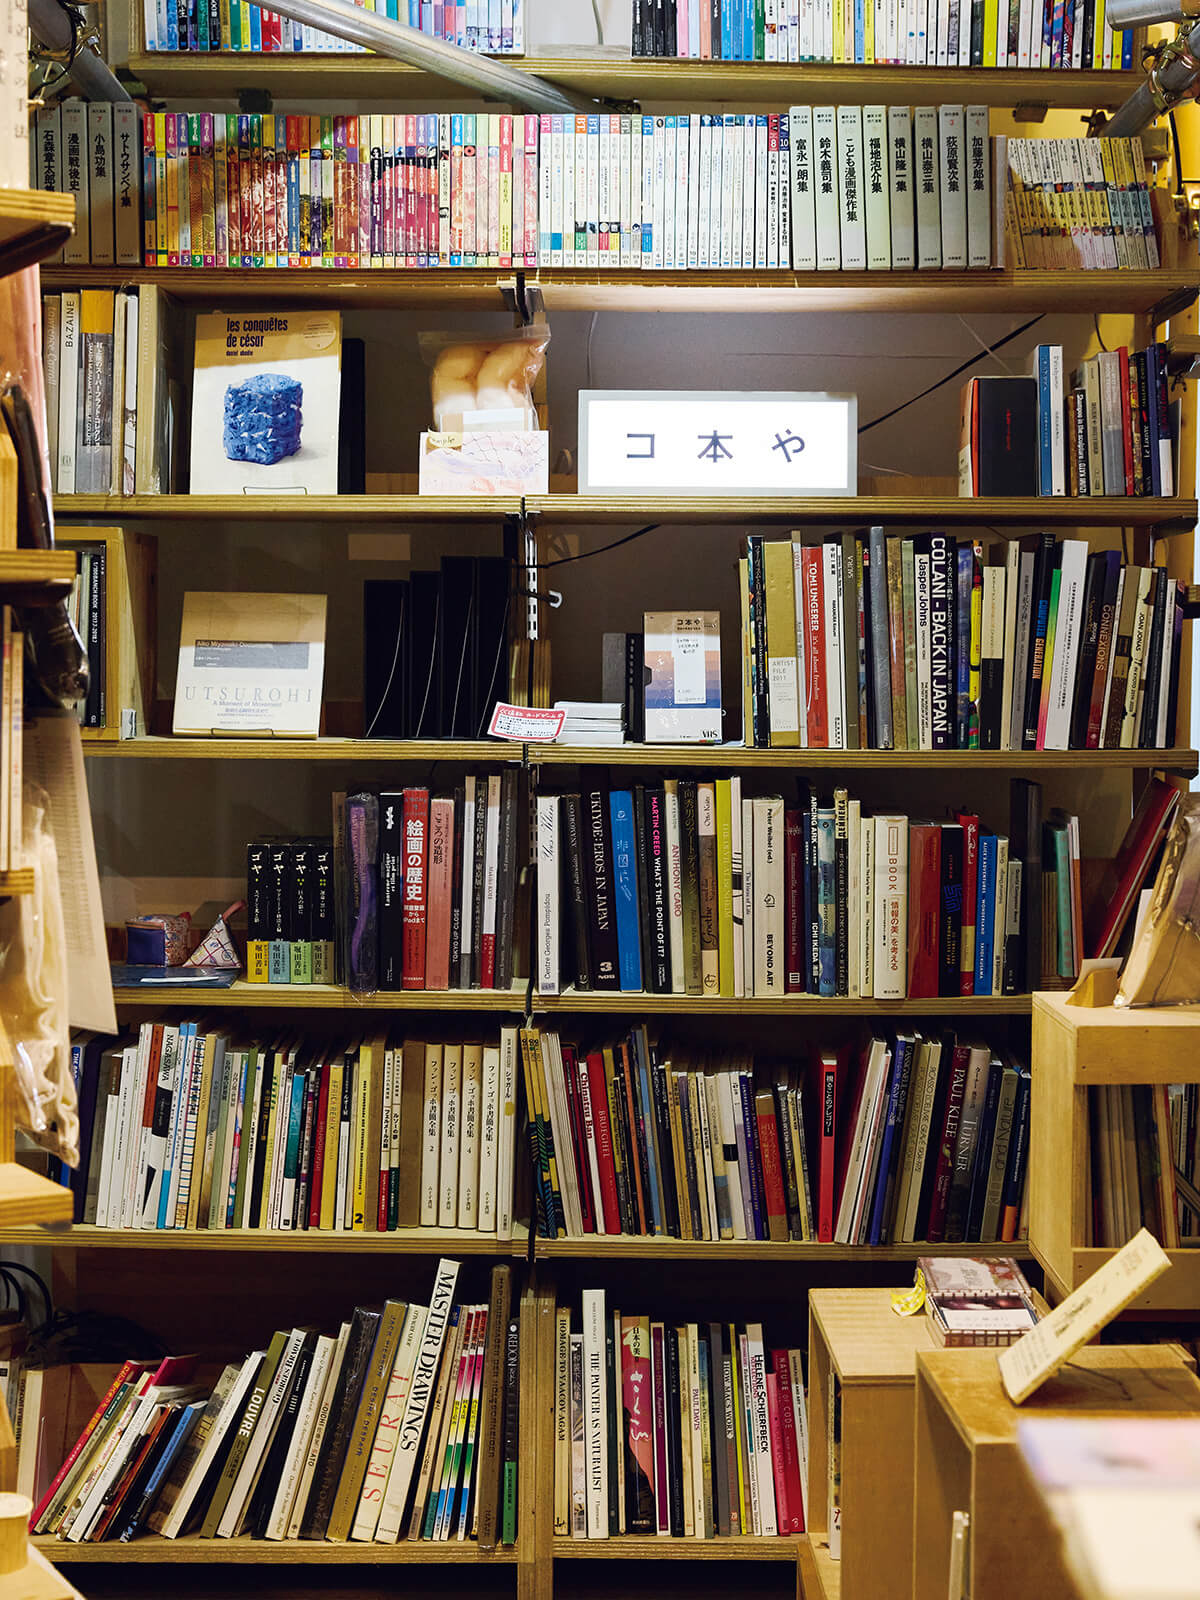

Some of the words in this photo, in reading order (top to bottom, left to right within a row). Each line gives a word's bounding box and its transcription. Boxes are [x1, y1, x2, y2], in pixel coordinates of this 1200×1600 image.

[94, 134, 106, 178] 小島功集
[770, 139, 776, 148] 8
[779, 138, 789, 147] 10
[68, 133, 81, 191] 漫画戦後史
[120, 133, 132, 207] サトウサンペイ集
[796, 138, 808, 193] 富永一朗集
[819, 137, 832, 194] 鈴木義司集
[869, 137, 882, 193] 福地泡介集
[894, 137, 907, 192] 横山隆一集
[921, 137, 934, 193] 横山泰三集
[971, 136, 984, 191] 加藤芳郎集
[845, 138, 858, 222] こども漫画傑作集
[65, 300, 75, 347] BAZAINE
[226, 334, 237, 347] de
[239, 332, 264, 347] césar
[227, 318, 240, 332] les
[243, 316, 288, 335] conquêtes
[626, 428, 806, 463] コ本や
[809, 562, 817, 586] TOMI
[918, 558, 929, 592] Jasper
[931, 537, 945, 598] COLANI
[810, 587, 819, 631] UNGERER
[919, 595, 929, 627] Johns
[1035, 600, 1048, 637] COMPUTER
[1138, 611, 1146, 629] JOAN
[932, 611, 946, 656] BACK
[1095, 603, 1115, 671] CONNEXIONS
[1135, 631, 1143, 651] JONAS
[933, 660, 946, 676] IN
[1032, 638, 1045, 680] GENERATION
[185, 686, 313, 703] UTSUROHI
[933, 680, 947, 730] JAPAN
[702, 729, 718, 739] VHS
[652, 797, 660, 828] MARTIN
[810, 796, 818, 825] ARCING
[837, 799, 847, 838] ДЕЙНЕКА
[433, 812, 443, 865] こころの造形
[653, 829, 661, 856] CREED
[251, 850, 263, 875] ゴヤ
[273, 850, 285, 875] ゴヤ
[296, 850, 307, 875] ゴヤ
[317, 850, 329, 875] ゴヤ
[406, 819, 424, 901] 絵画の歴史
[594, 842, 605, 873] EROS
[654, 857, 662, 888] WHAT'S
[672, 844, 681, 891] ANTHONY
[888, 858, 898, 890] BOOK
[596, 877, 606, 889] IN
[543, 893, 551, 926] Pompidou
[596, 894, 609, 930] JAPAN
[674, 892, 682, 917] CARO
[544, 928, 552, 956] Georges
[657, 933, 664, 944] OF
[702, 905, 717, 945] Goethe
[452, 942, 460, 963] TOKYO
[544, 957, 552, 979] Centre
[657, 945, 665, 957] IT?
[766, 934, 774, 968] BEYOND
[766, 970, 774, 986] ART
[161, 1034, 174, 1082] NAGASAWA
[580, 1072, 593, 1118] Chinatsu
[925, 1065, 937, 1093] PICASSO
[950, 1068, 966, 1102] PAUL
[428, 1060, 437, 1136] ファン・ゴッホ書簡全集
[447, 1062, 457, 1137] ファン・ゴッホ書簡全集
[466, 1061, 476, 1138] ファン・ゴッホ書簡全集
[486, 1065, 495, 1141] ファン・ゴッホ書簡全集
[584, 1119, 594, 1139] Ban
[598, 1110, 611, 1158] BRUEGHEL
[945, 1104, 961, 1138] KLEE
[955, 1115, 978, 1172] TURNER
[355, 1213, 364, 1224] 2
[388, 1314, 397, 1337] JACK
[422, 1272, 456, 1347] MASTER
[508, 1333, 519, 1368] REDON
[558, 1319, 568, 1359] HOMAGE
[632, 1327, 641, 1356] 日本の美
[377, 1337, 391, 1378] PIERSON
[558, 1360, 567, 1372] TO
[590, 1352, 601, 1372] THE
[722, 1361, 732, 1383] HOW
[754, 1354, 765, 1390] HELENE
[779, 1357, 789, 1391] NATURE
[271, 1368, 289, 1404] GEORGES
[558, 1373, 567, 1412] YAACOV
[590, 1374, 601, 1414] PAINTER
[750, 1356, 759, 1399] REFLECTIONS
[239, 1386, 266, 1438] LOUVRE
[367, 1386, 379, 1418] DESIRE
[400, 1350, 438, 1452] DRAWINGS
[692, 1388, 701, 1407] PAUL
[724, 1386, 733, 1407] MACS
[319, 1402, 328, 1428] KOICHI
[558, 1413, 567, 1441] AGAM
[591, 1418, 601, 1429] AS
[692, 1408, 701, 1431] DAVIS
[724, 1408, 734, 1436] WORK
[756, 1391, 769, 1454] SCHJERFBECK
[783, 1406, 793, 1429] CODE
[355, 1419, 369, 1457] DESPAIR
[363, 1369, 409, 1503] SEURAT
[307, 1449, 317, 1467] SATO
[591, 1431, 602, 1492] NATURALIST
